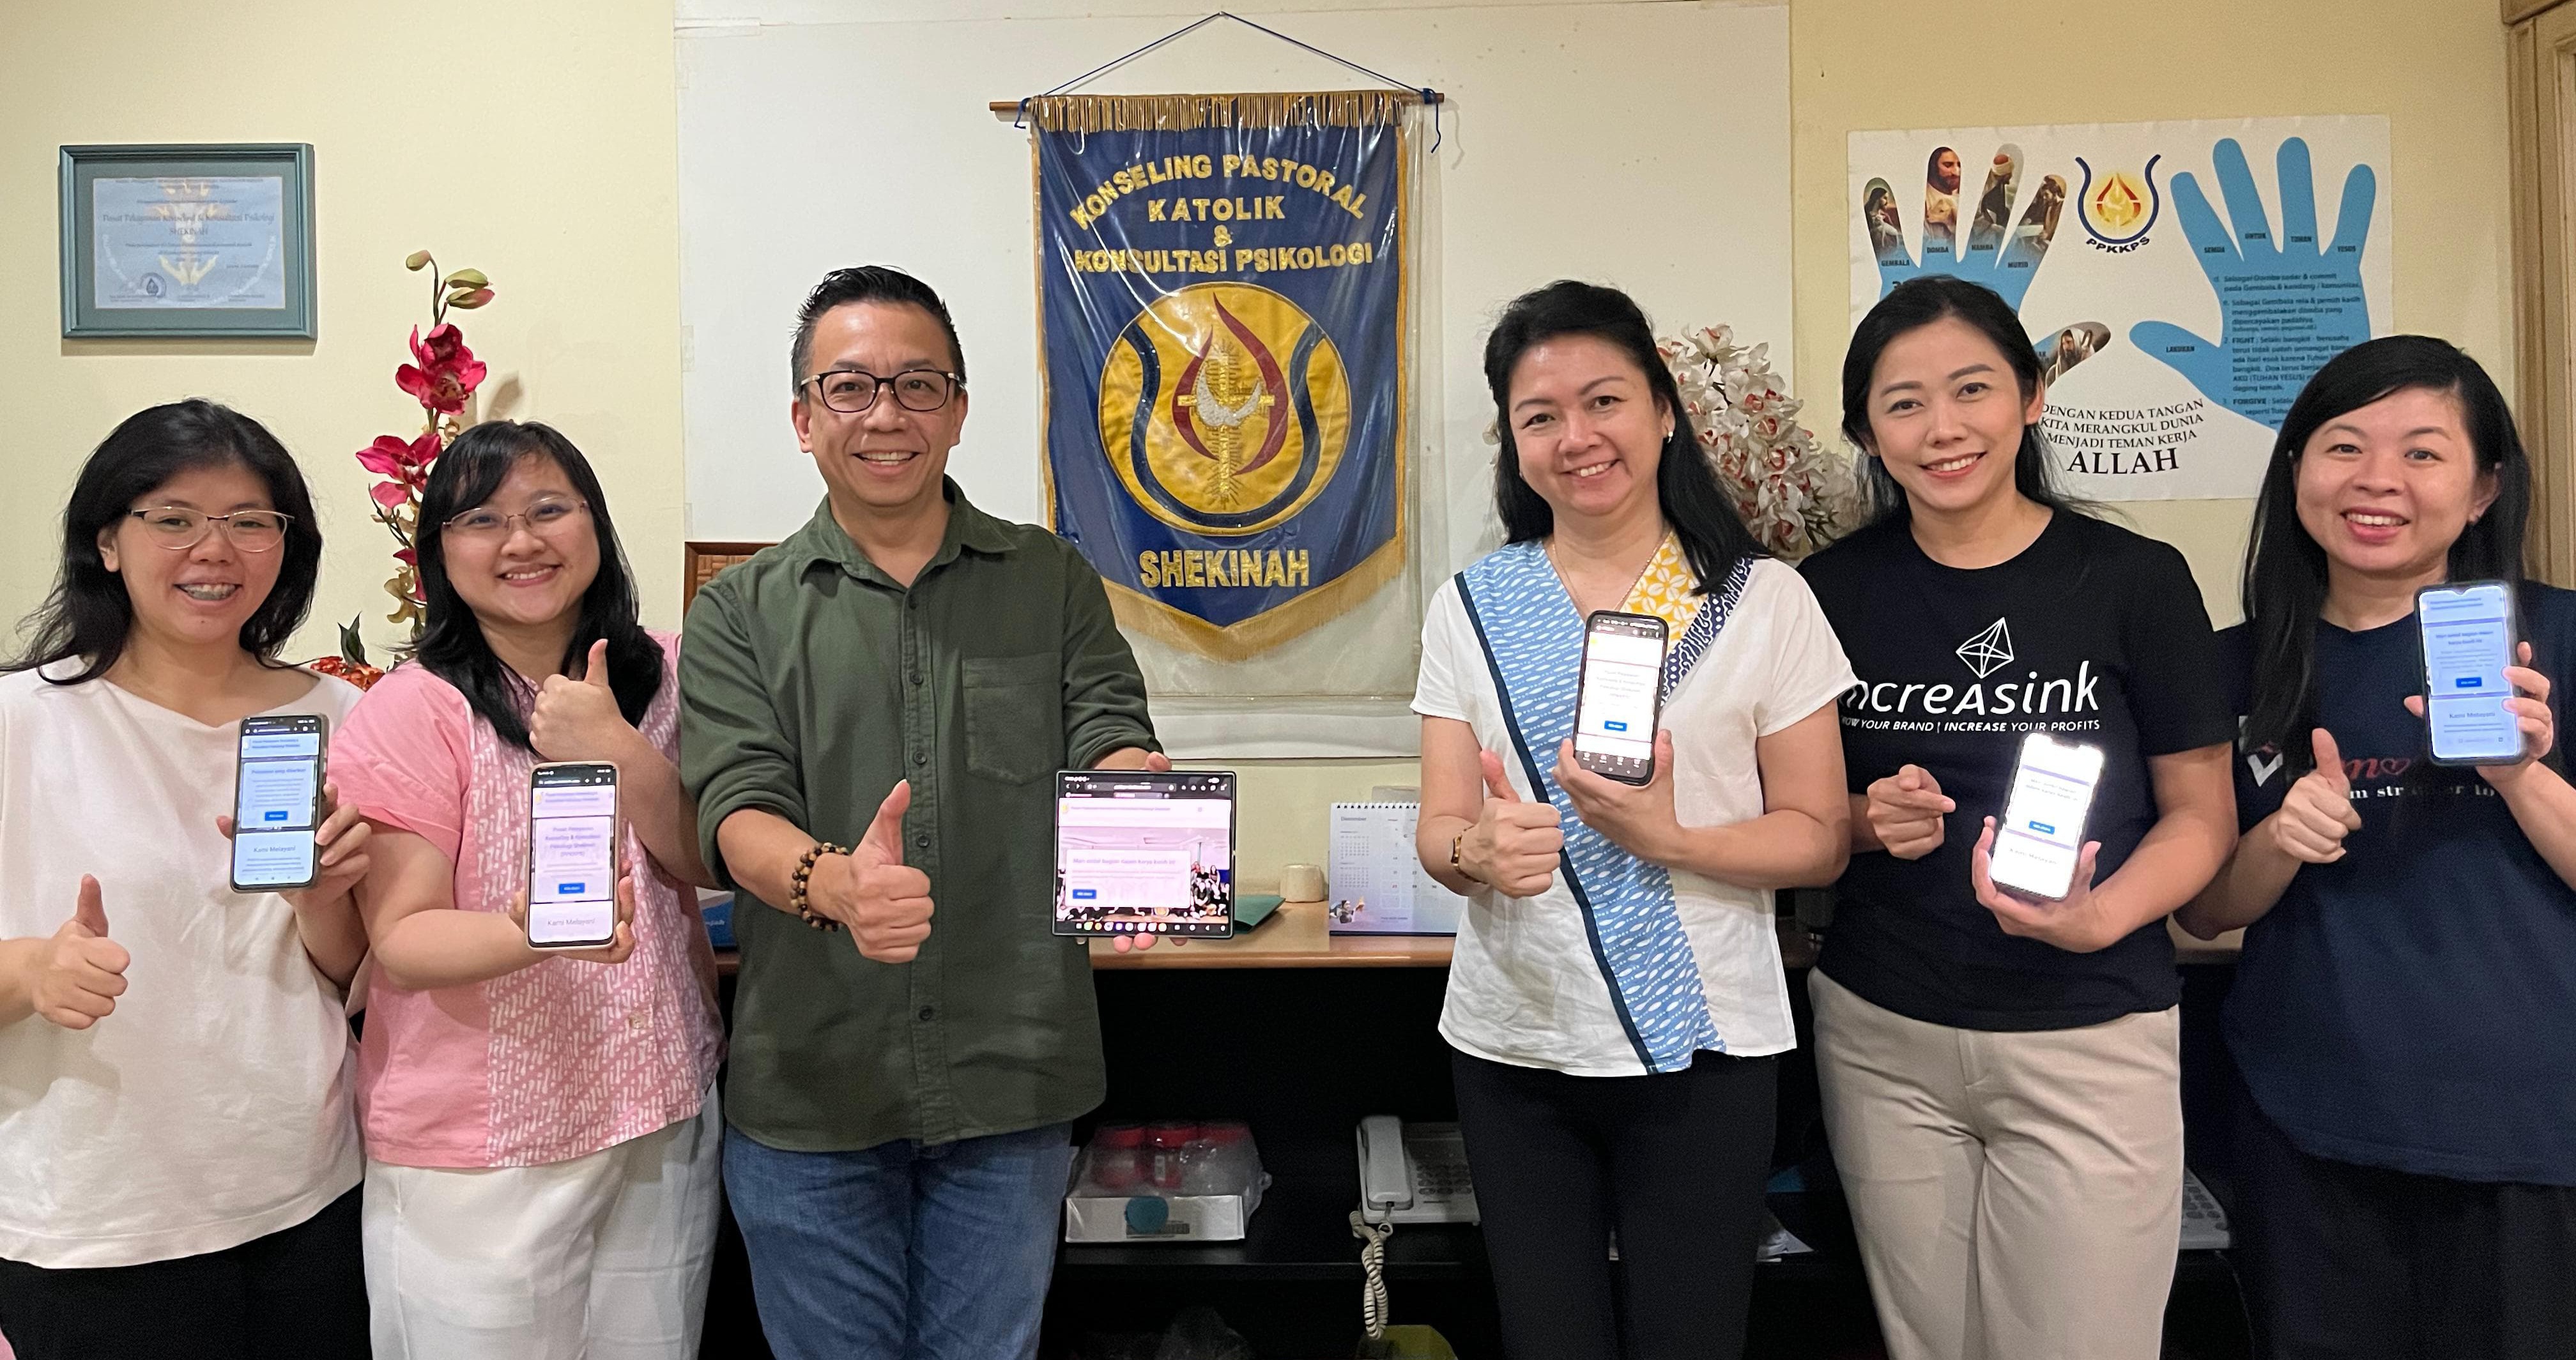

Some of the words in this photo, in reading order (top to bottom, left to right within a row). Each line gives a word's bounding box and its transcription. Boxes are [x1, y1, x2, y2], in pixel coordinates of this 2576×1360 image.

[1070, 155, 1212, 231] KONSELING
[1223, 155, 1368, 219] PASTORAL
[1147, 195, 1285, 222] KATOLIK
[1214, 225, 1233, 247] &
[2085, 236, 2150, 253] PPKKPS
[1074, 249, 1227, 275] KONSULTASI
[1236, 242, 1373, 273] PSIKOLOGI
[2099, 410, 2143, 420] KEDUA
[2147, 398, 2204, 418] TANGAN
[2041, 416, 2069, 431] KITA
[2073, 422, 2157, 434] MERANGKUL
[2160, 414, 2204, 431] DUNIA
[2046, 432, 2103, 448] MENJADI
[2107, 436, 2154, 448] TEMAN
[2158, 429, 2197, 446] KERJA
[2067, 447, 2179, 475] ALLAH
[1139, 549, 1309, 588] SHEKINAH
[1861, 720, 1890, 730] YOUR
[1892, 721, 1934, 732] BRAND
[1944, 722, 2007, 732] INCREASE
[2011, 722, 2046, 731] YOUR
[2051, 719, 2100, 731] PROFITS
